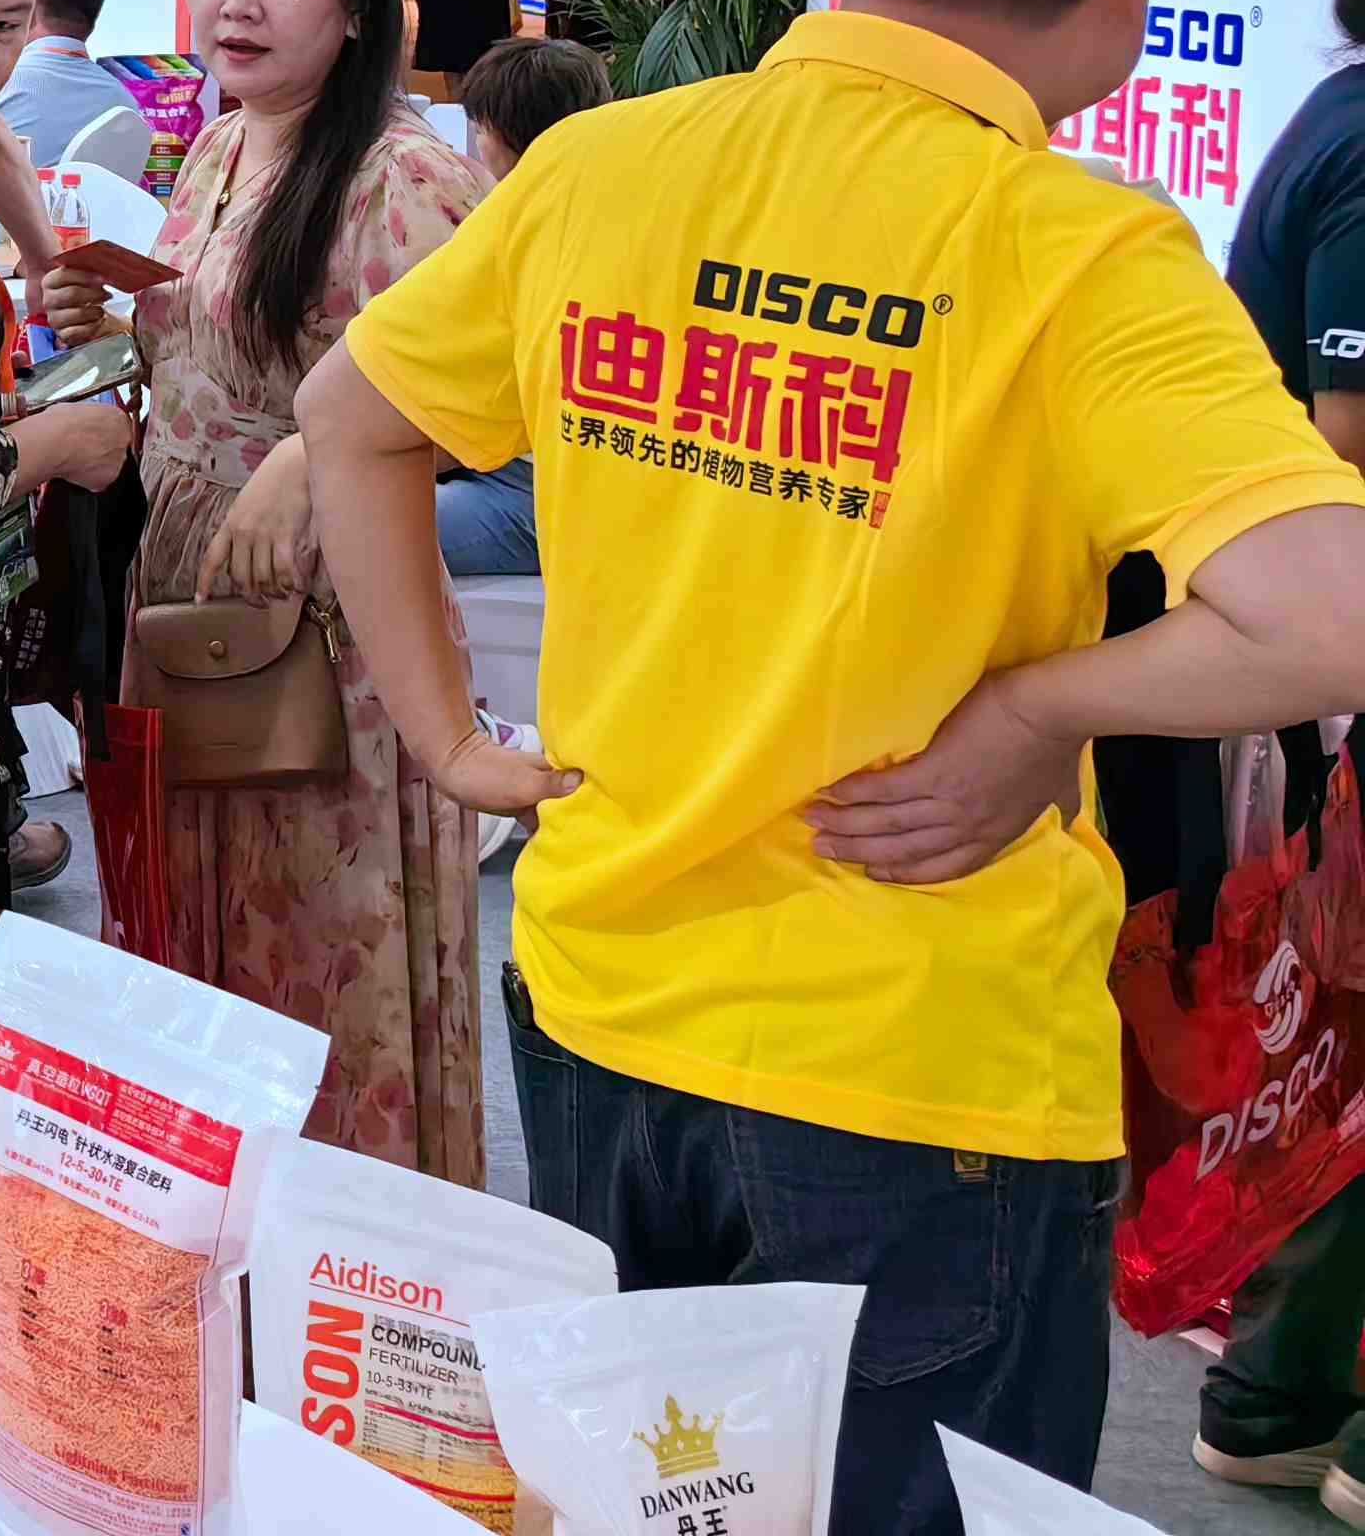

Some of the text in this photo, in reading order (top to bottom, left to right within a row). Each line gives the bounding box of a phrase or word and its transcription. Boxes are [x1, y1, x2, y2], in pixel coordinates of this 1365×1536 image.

[693, 259, 927, 349] DISCO
[559, 299, 914, 484] 迪斯科
[1195, 1027, 1335, 1183] DISCO
[309, 1252, 445, 1312] Aidison
[368, 1347, 460, 1385] FERTILIZER
[640, 1471, 756, 1519] DANWANG
